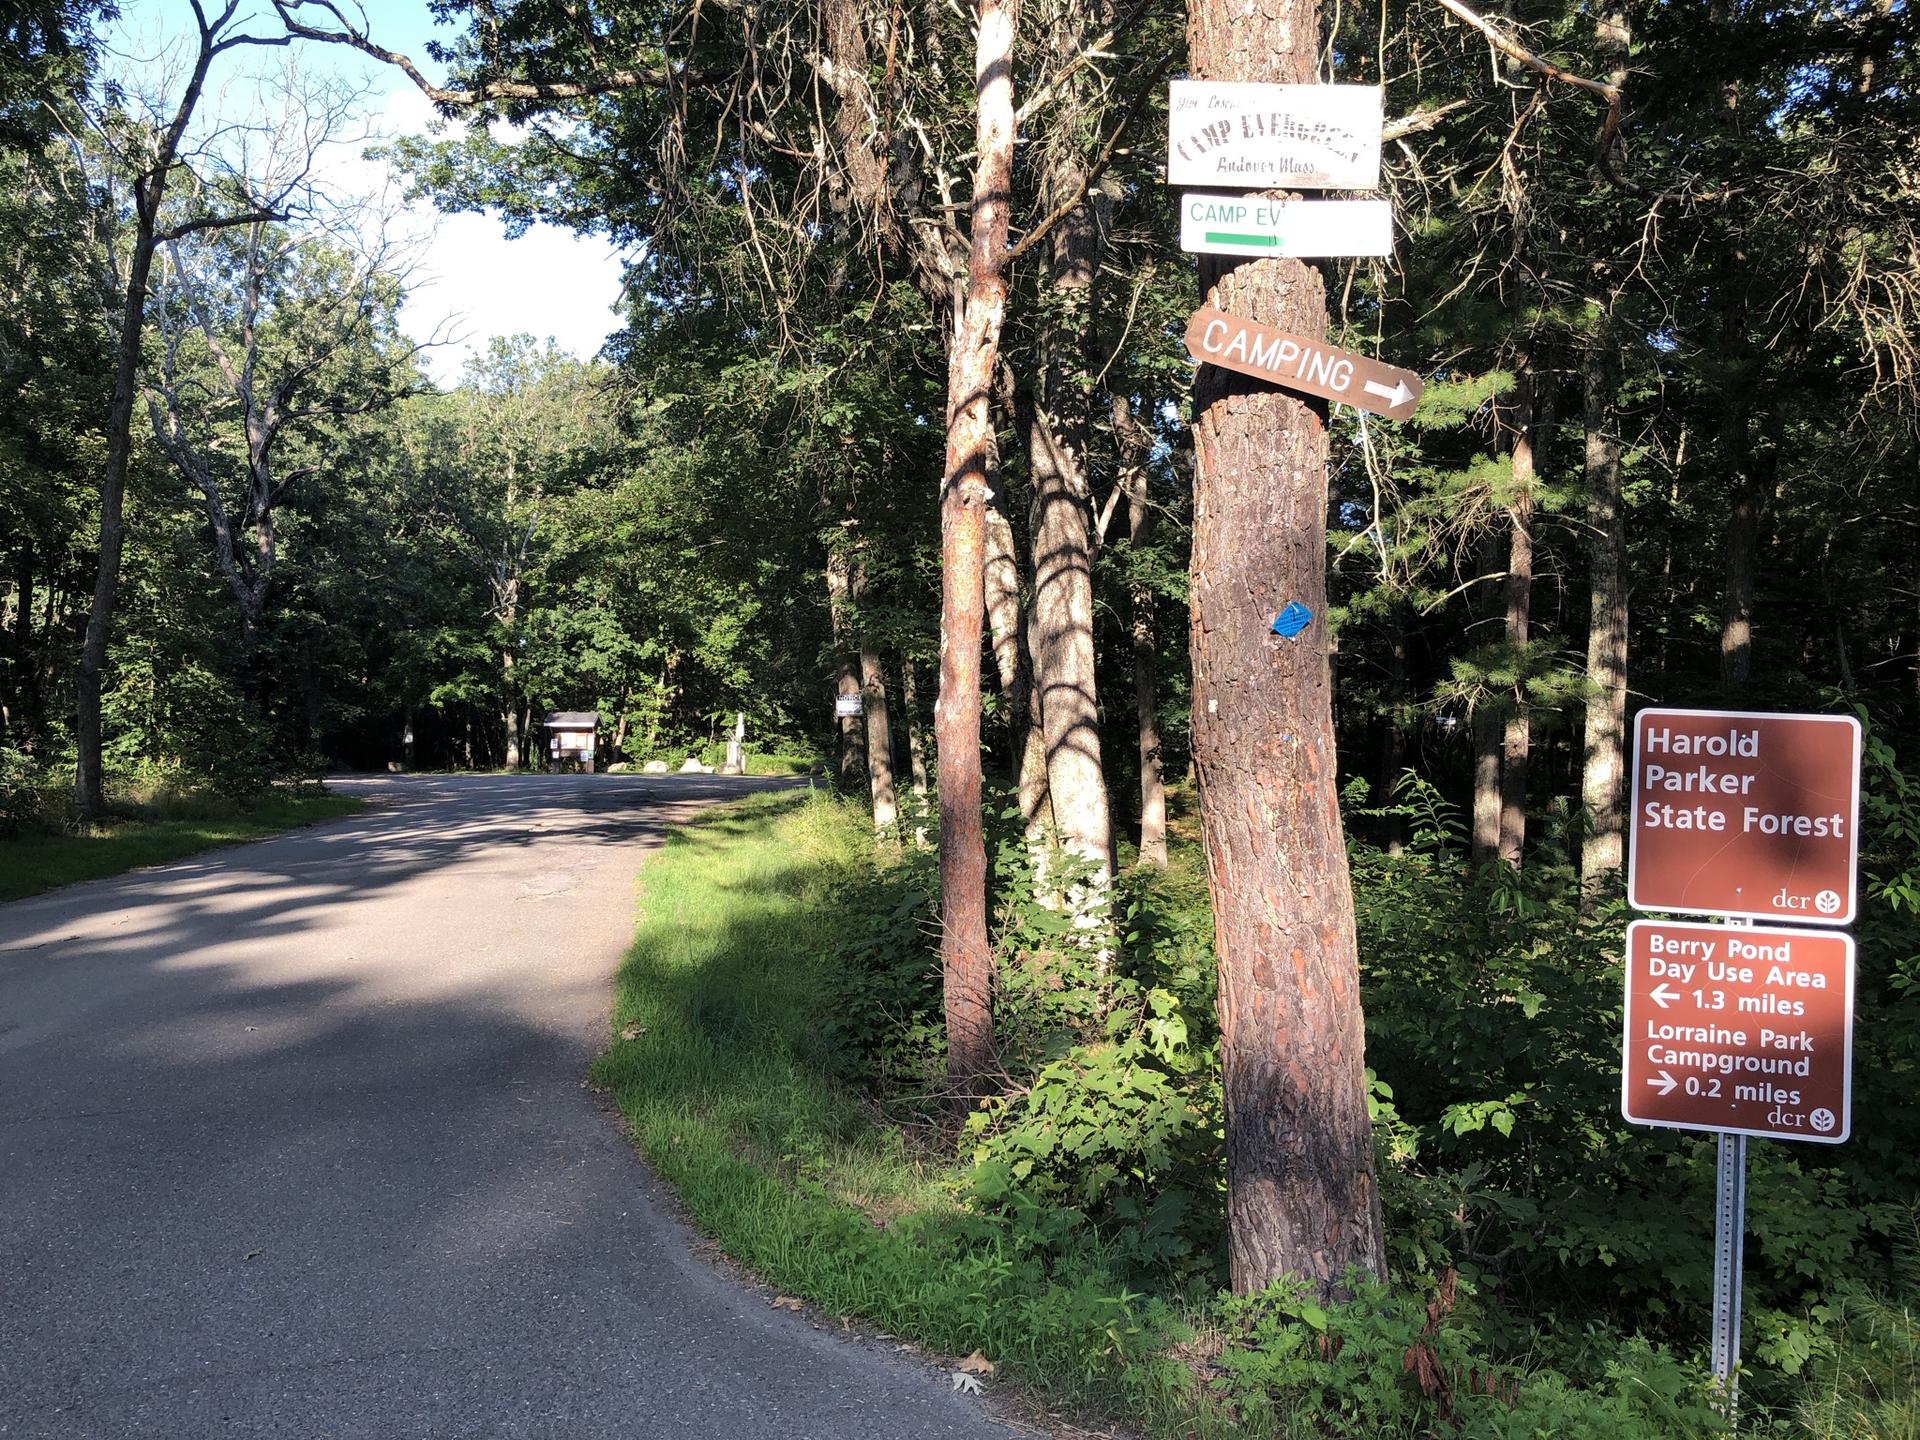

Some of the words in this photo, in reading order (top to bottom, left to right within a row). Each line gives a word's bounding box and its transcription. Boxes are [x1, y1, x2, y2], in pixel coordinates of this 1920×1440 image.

[1177, 119, 1231, 161] CAMP
[1241, 113, 1366, 163] EVERGRE
[1217, 157, 1274, 173] Andover
[1190, 203, 1247, 224] CAMP
[1203, 319, 1354, 392] CAMPING
[1647, 727, 1759, 758] Harold
[1645, 764, 1755, 795] Parker
[1645, 801, 1726, 831] State
[1743, 807, 1844, 838] Forest
[1772, 888, 1810, 909] dcr
[1650, 934, 1715, 961] Berry
[1728, 939, 1790, 962] Pond
[1649, 957, 1696, 983] Day
[1707, 961, 1753, 983] Use
[1765, 966, 1826, 989] Area
[1692, 989, 1726, 1010] 1.3
[1738, 993, 1804, 1016] miles
[1648, 1019, 1747, 1046] Lorraine
[1760, 1028, 1814, 1052] Park
[1647, 1045, 1809, 1077] Campground
[1685, 1076, 1722, 1098] 0.2
[1734, 1082, 1801, 1105] miles
[1767, 1105, 1805, 1127] dcr
